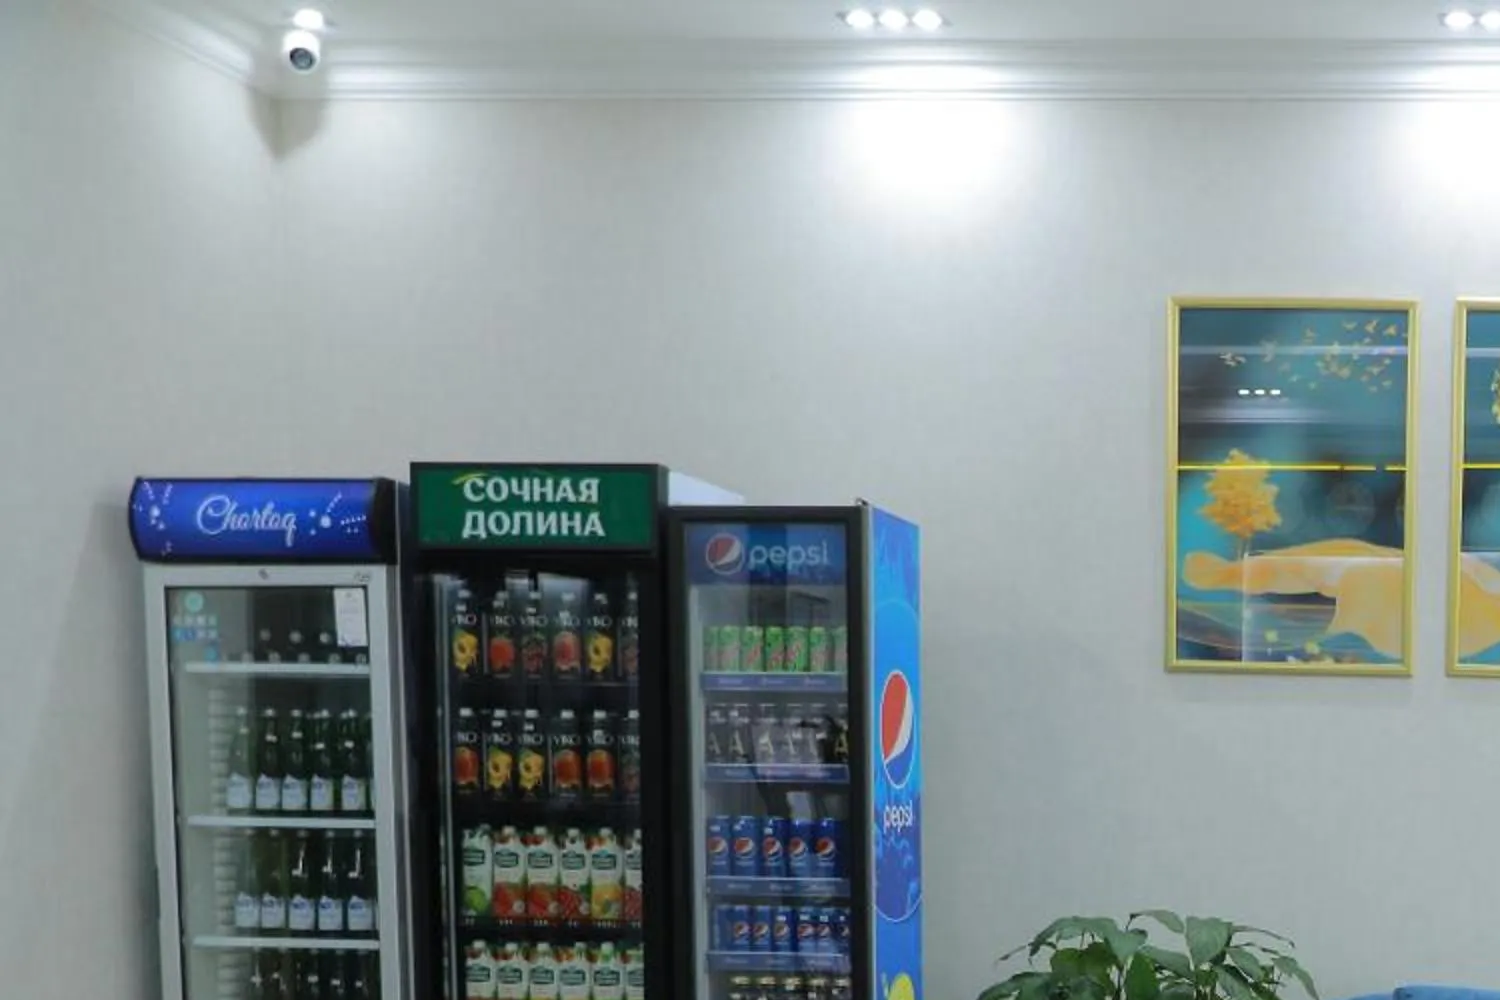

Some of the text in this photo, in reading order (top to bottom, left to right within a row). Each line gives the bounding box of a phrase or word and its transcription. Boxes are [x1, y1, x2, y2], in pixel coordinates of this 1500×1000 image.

[463, 476, 601, 503] СОЧНАЯ
[461, 509, 607, 540] ДОЛИНА
[748, 539, 829, 571] pepsi
[882, 799, 914, 835] pepsi
